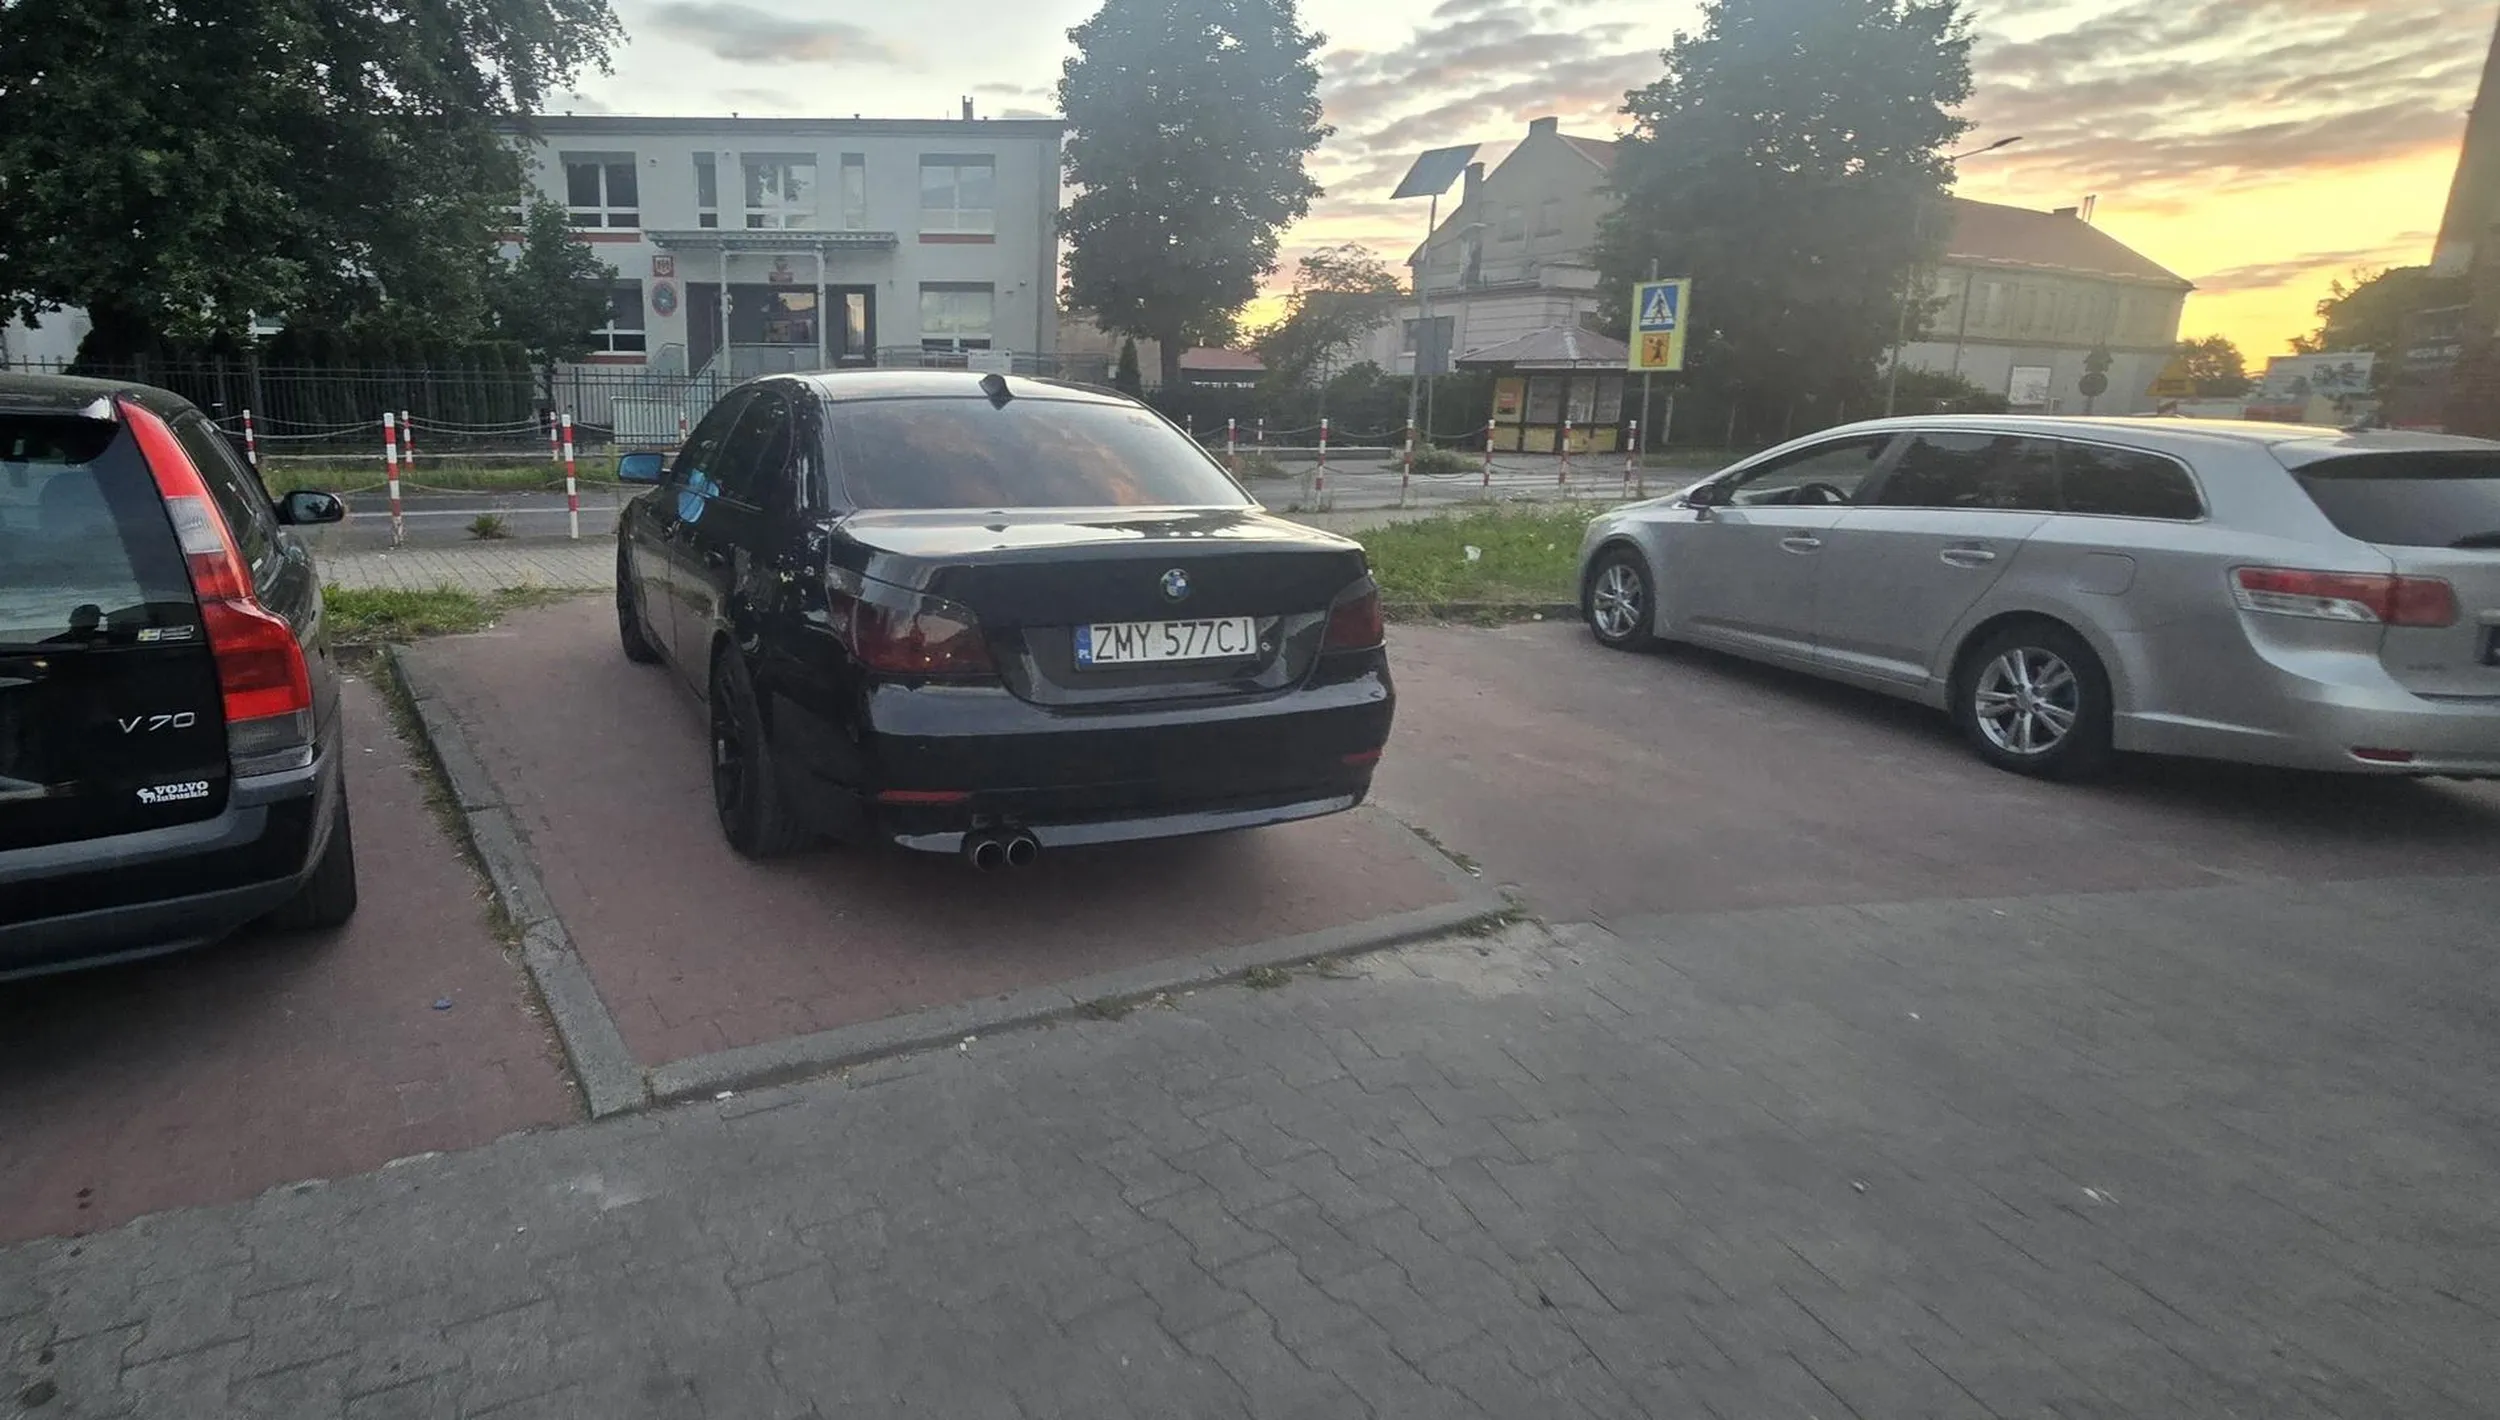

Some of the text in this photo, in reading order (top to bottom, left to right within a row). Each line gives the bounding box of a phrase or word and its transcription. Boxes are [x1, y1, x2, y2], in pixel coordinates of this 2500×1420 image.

[1093, 619, 1249, 661] ZMY 577CJ
[1078, 649, 1091, 660] PL
[154, 780, 209, 794] VOLVO
